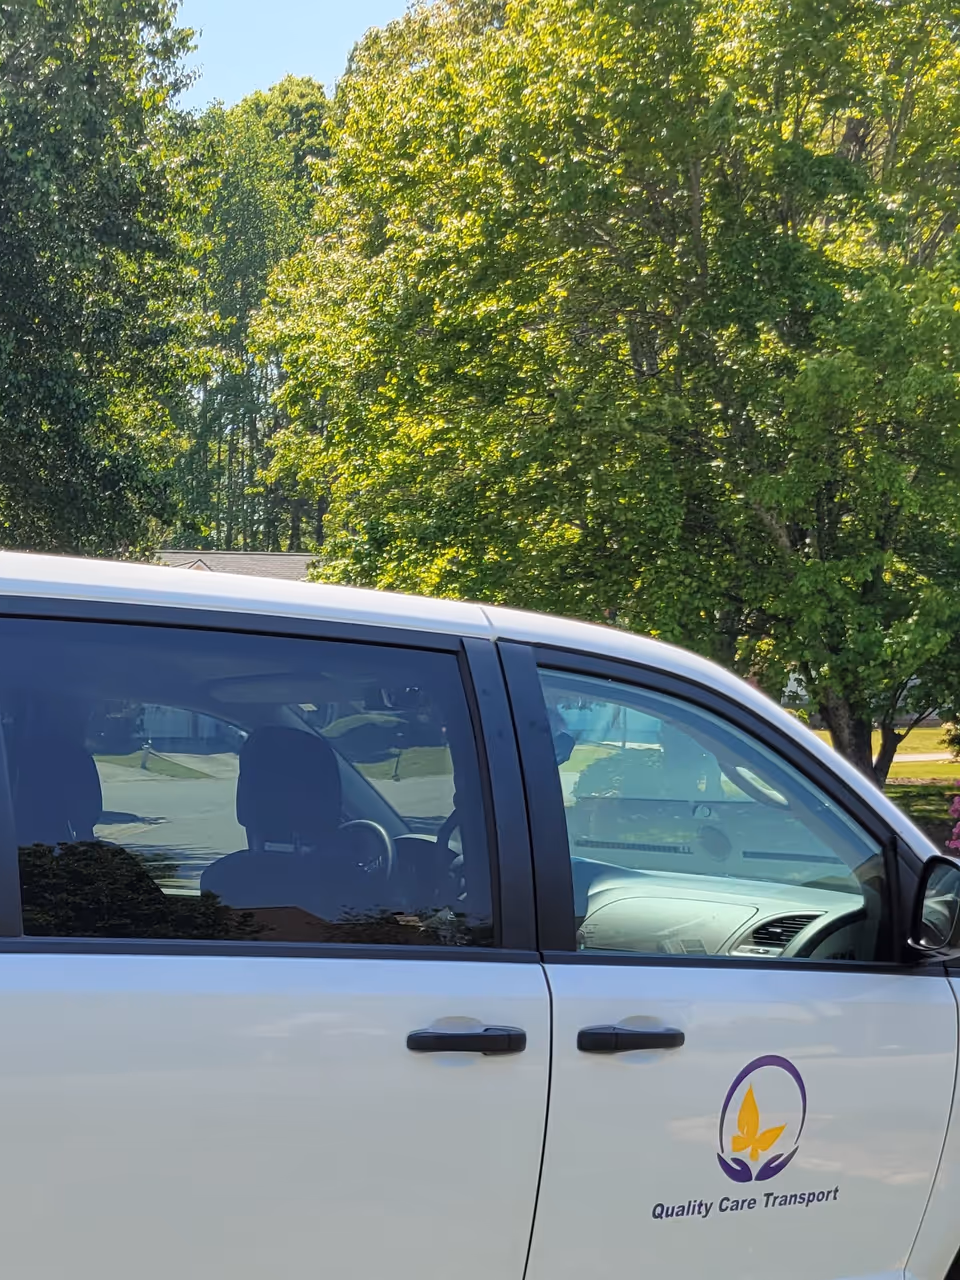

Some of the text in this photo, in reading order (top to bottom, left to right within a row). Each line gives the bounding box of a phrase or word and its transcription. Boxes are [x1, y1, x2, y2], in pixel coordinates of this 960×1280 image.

[651, 1185, 840, 1220] Quality Care Transport
